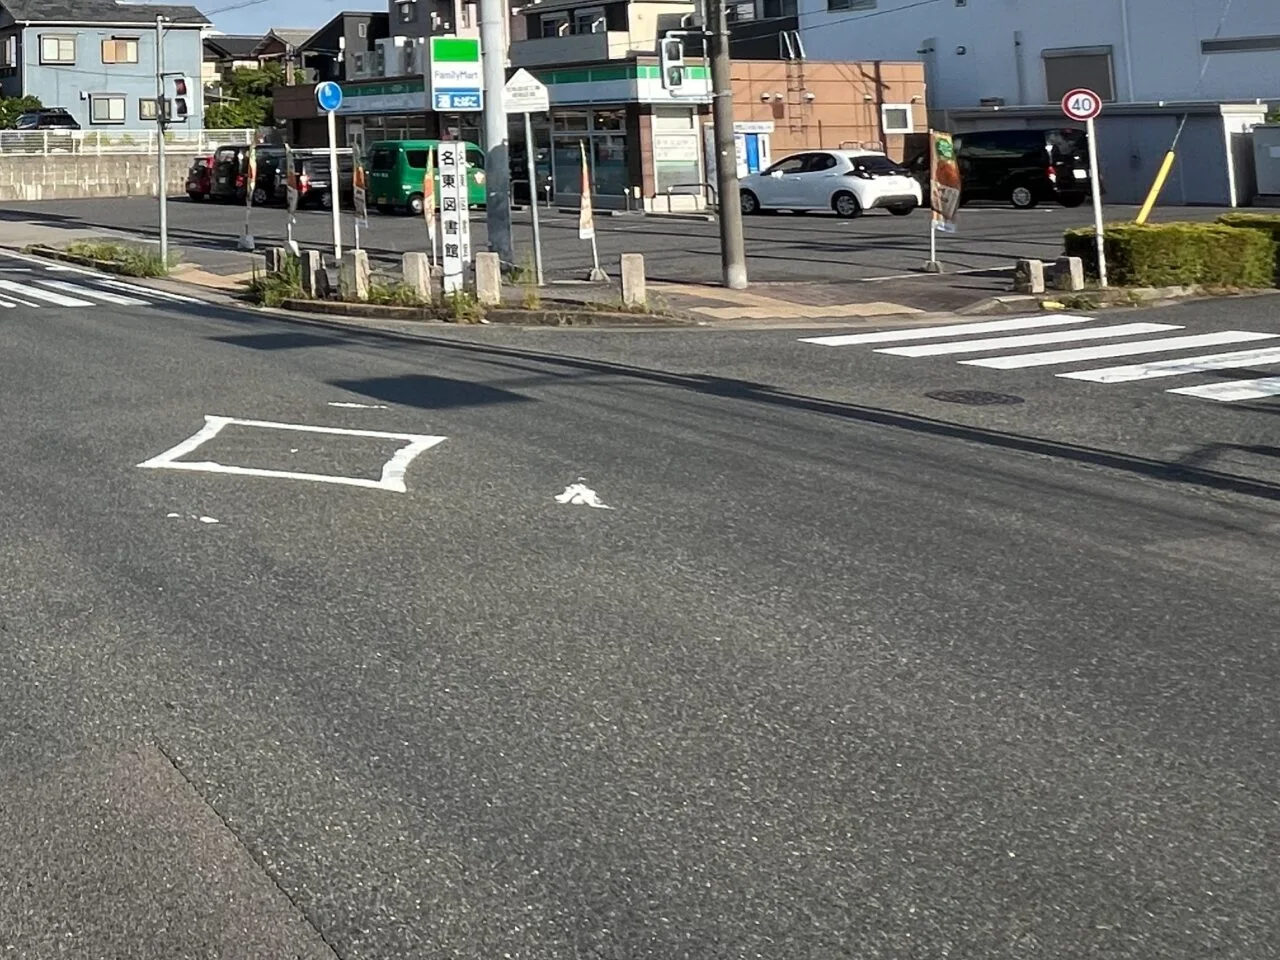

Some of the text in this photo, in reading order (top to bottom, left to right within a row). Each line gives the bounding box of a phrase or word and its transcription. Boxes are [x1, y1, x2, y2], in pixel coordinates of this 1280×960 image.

[434, 70, 478, 81] FamilyMart
[1071, 98, 1092, 111] 40
[441, 150, 459, 259] 名東図書館
